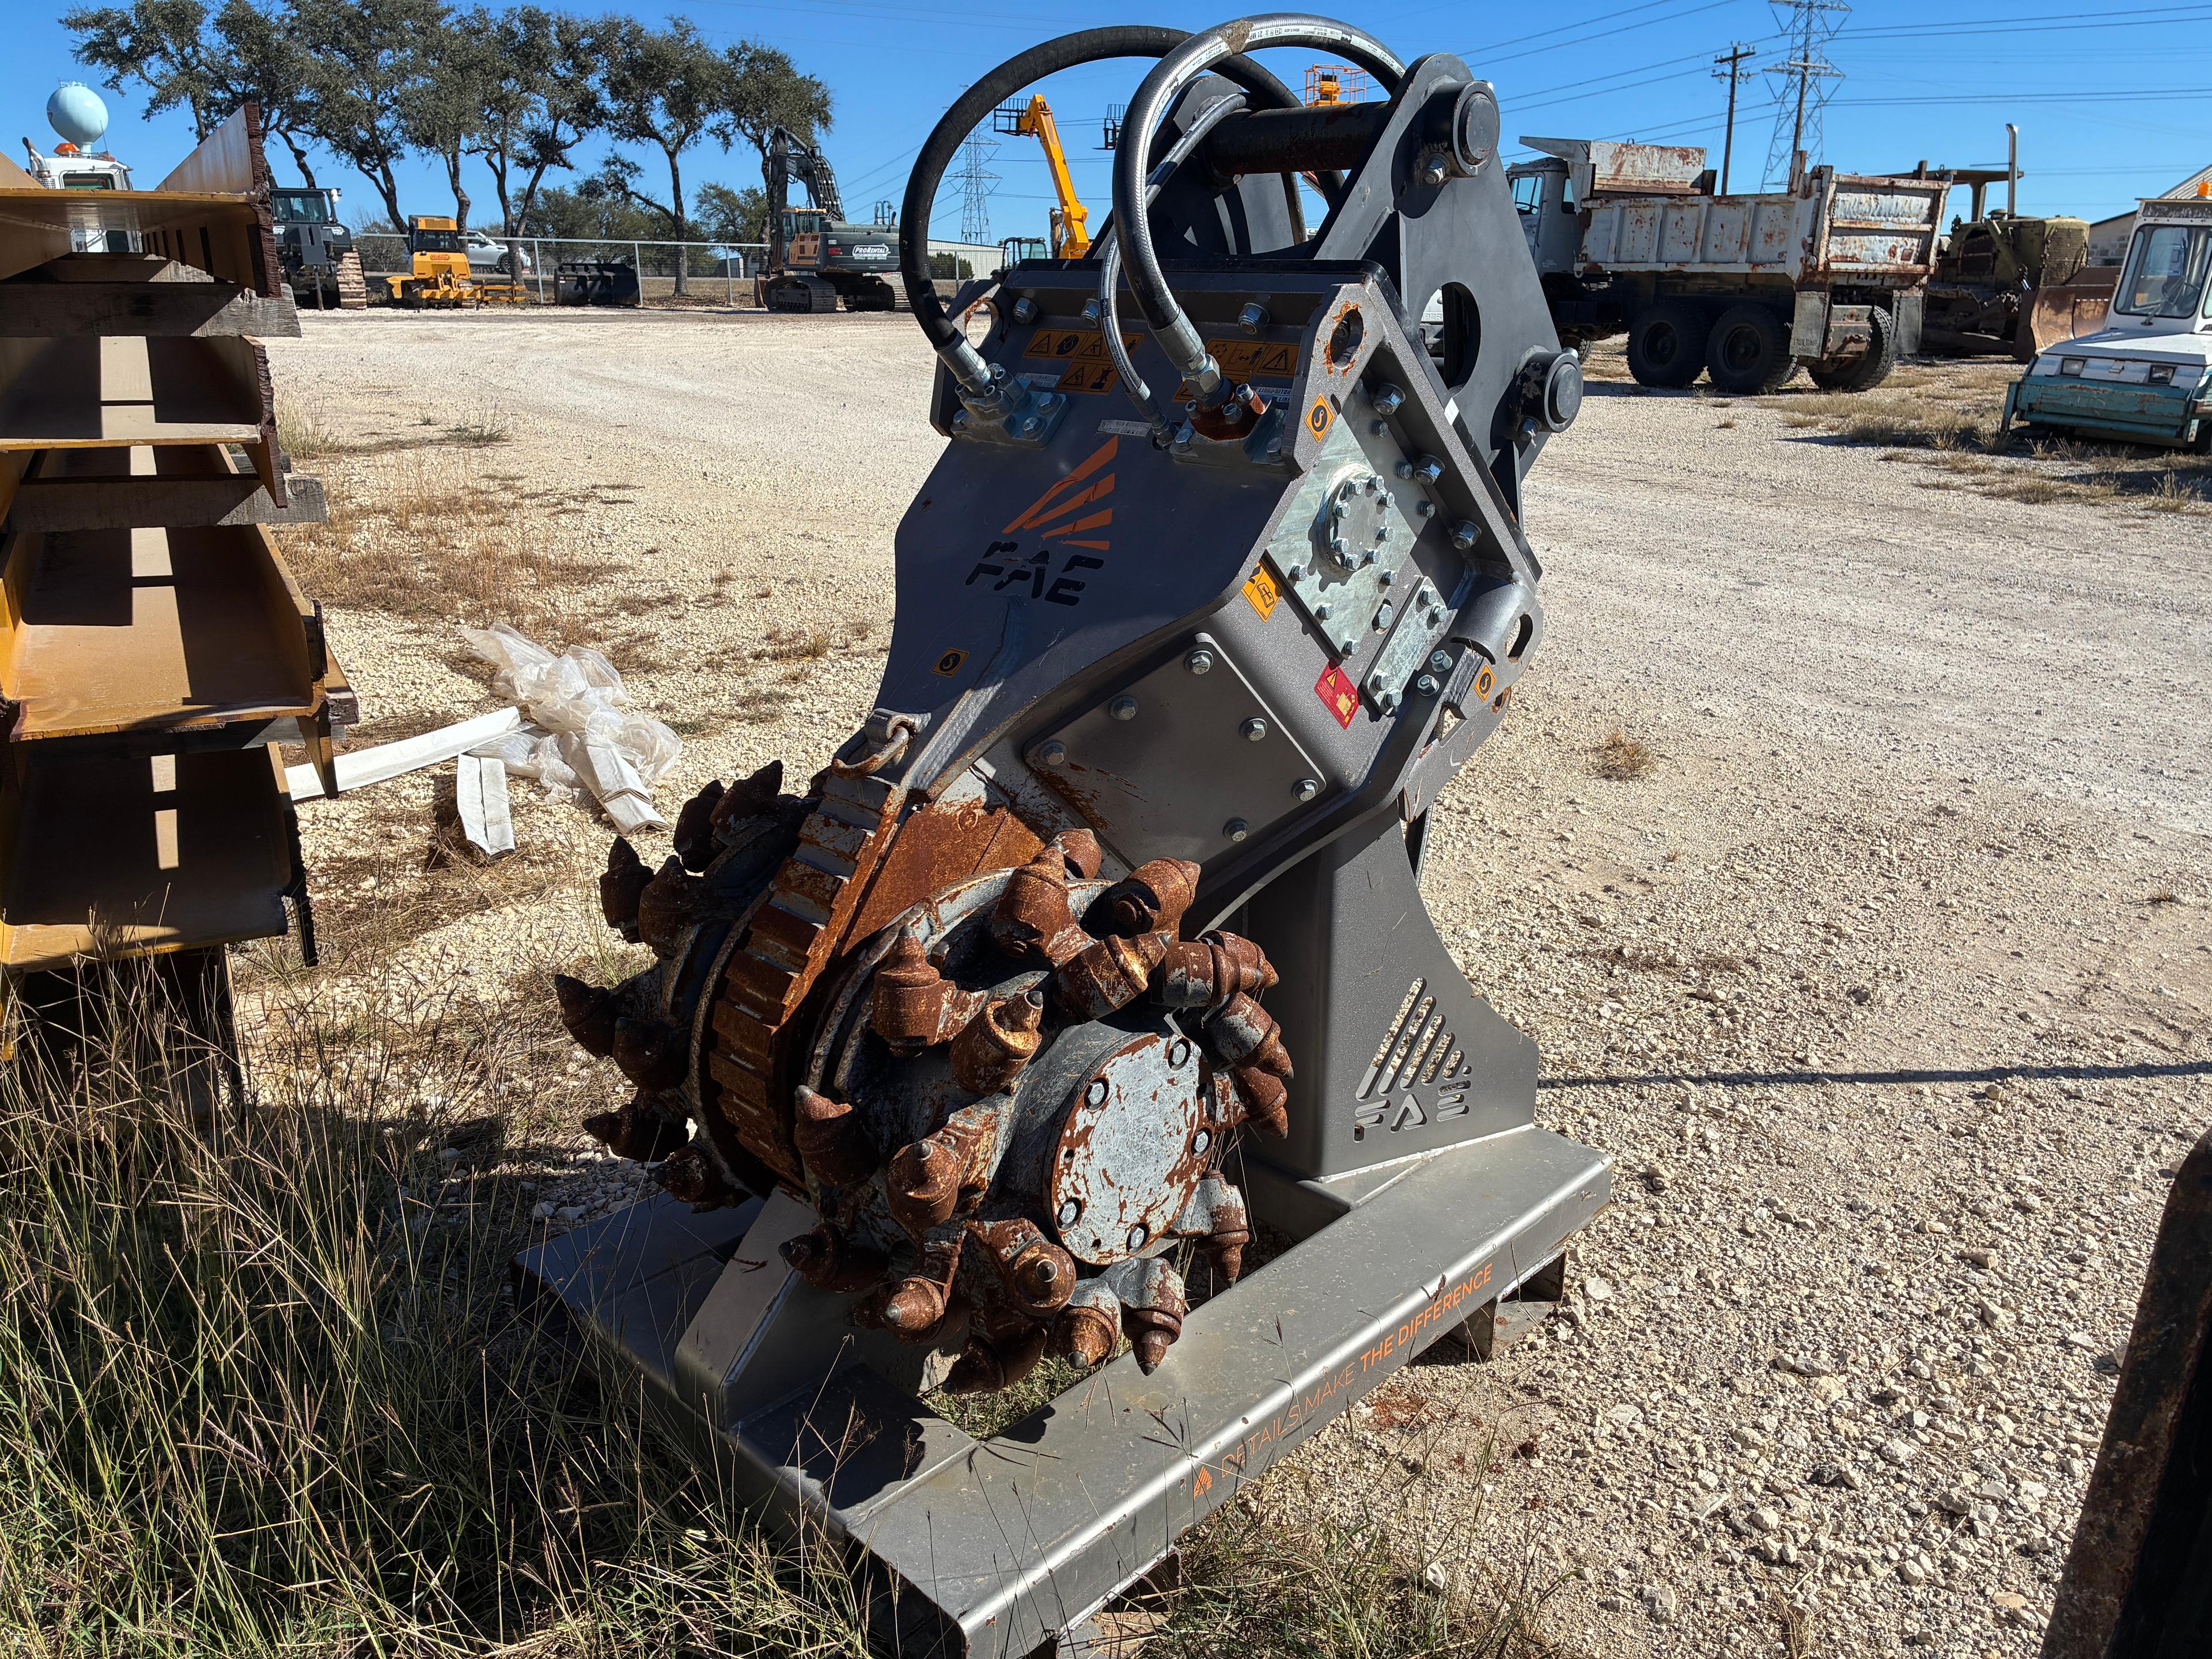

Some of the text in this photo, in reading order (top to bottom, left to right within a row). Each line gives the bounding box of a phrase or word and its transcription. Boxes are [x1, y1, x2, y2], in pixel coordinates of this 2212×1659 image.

[964, 540, 1104, 607] FAE
[1354, 1080, 1471, 1143] FAE
[1221, 1404, 1300, 1478] DETAILS
[1304, 1362, 1355, 1415] MAKE
[1360, 1334, 1394, 1373] THE
[1398, 1263, 1493, 1346] DIFFERENCE
